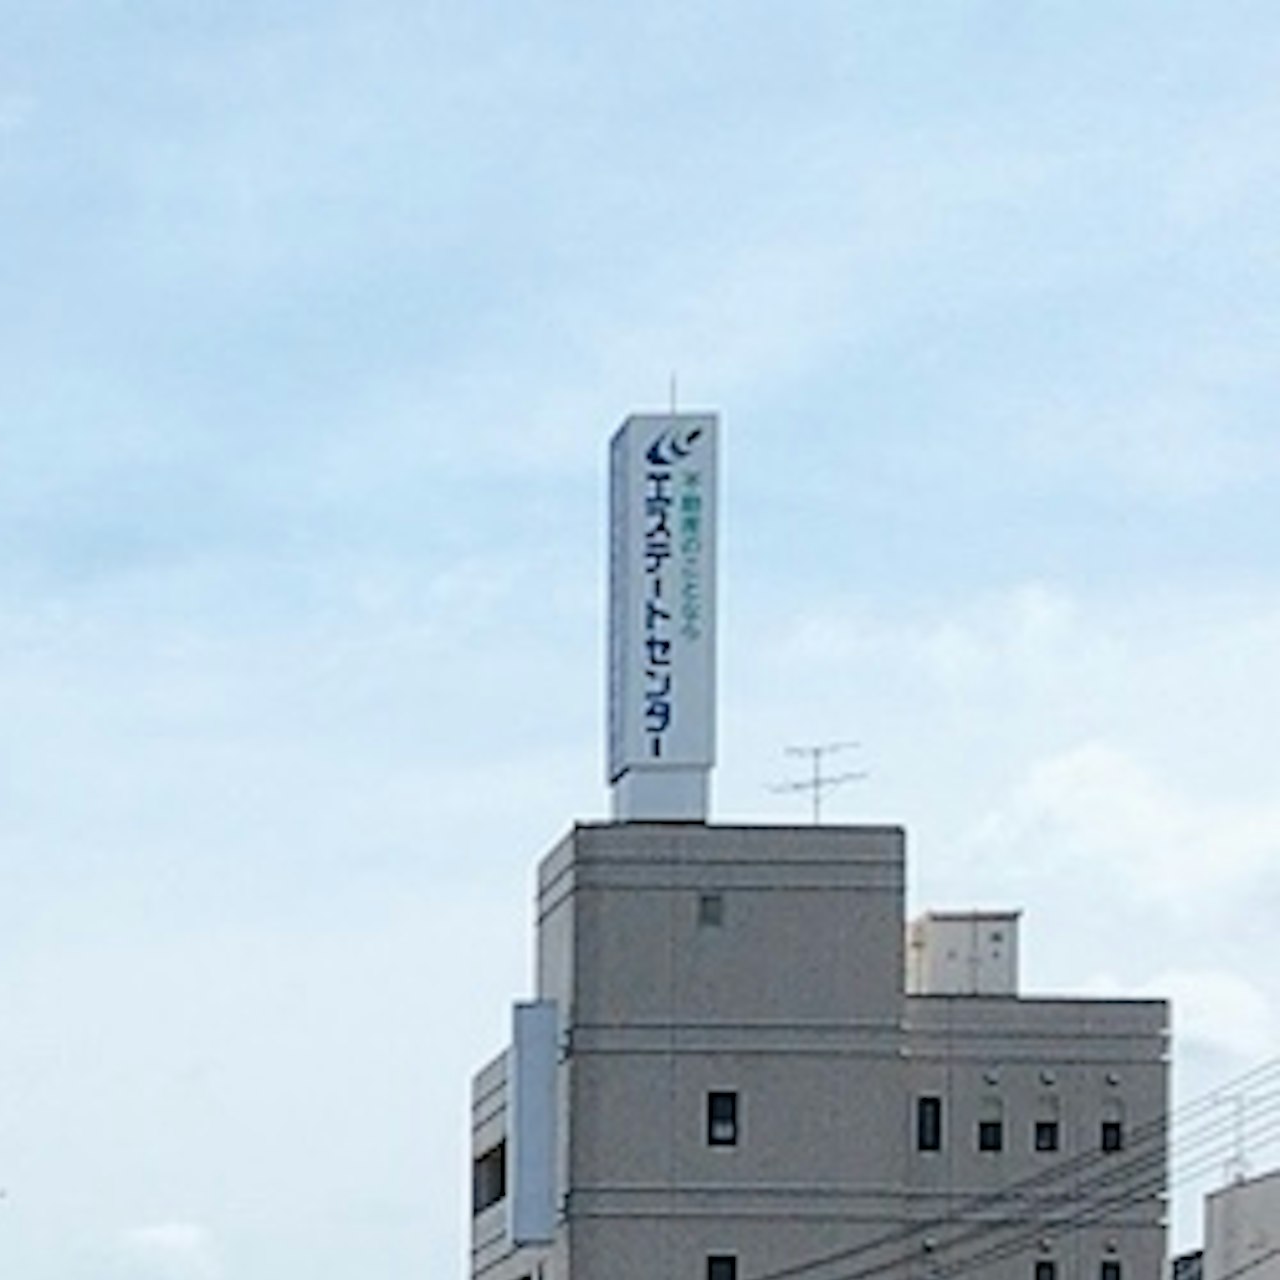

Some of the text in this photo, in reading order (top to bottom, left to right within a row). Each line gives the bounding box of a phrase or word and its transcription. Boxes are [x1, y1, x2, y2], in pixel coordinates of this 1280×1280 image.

[646, 473, 671, 757] エステートセンター
